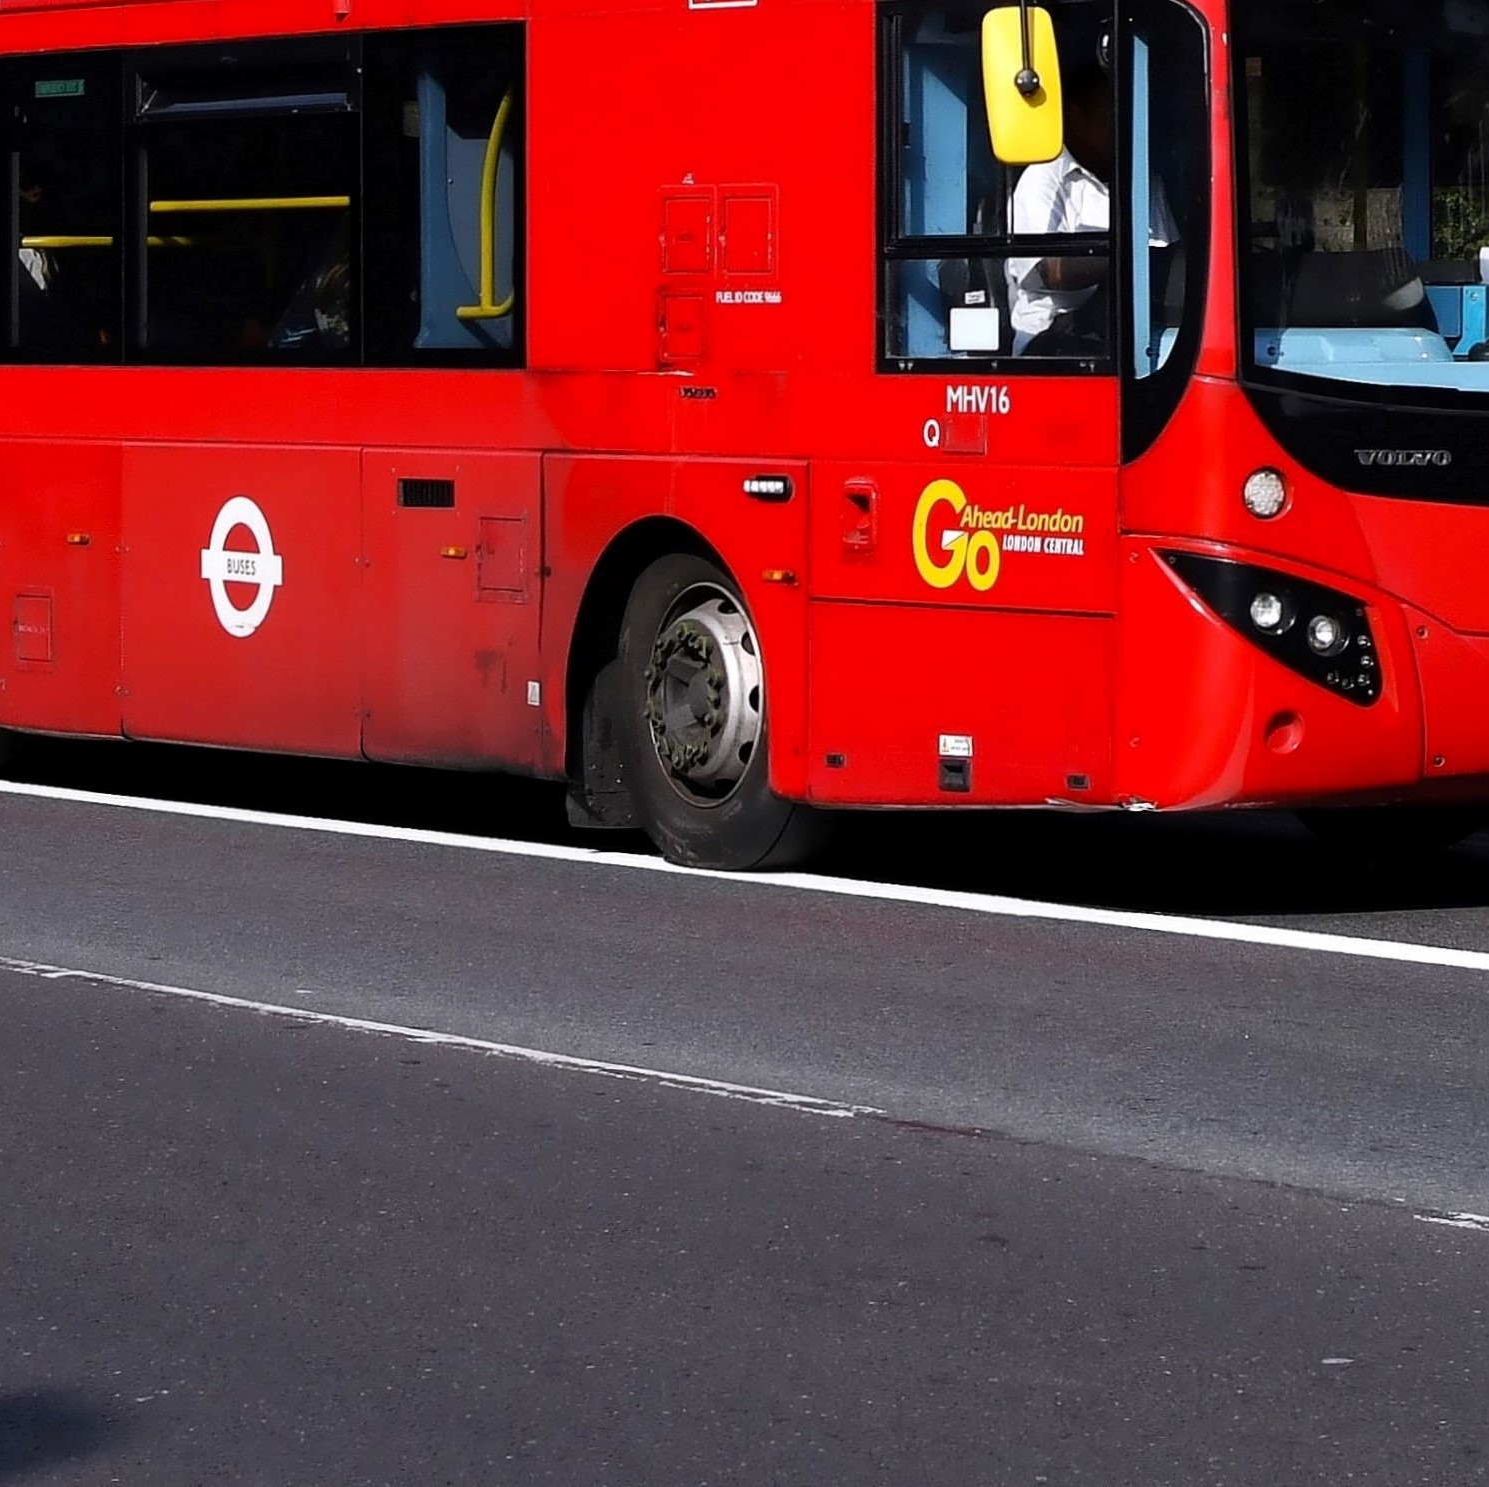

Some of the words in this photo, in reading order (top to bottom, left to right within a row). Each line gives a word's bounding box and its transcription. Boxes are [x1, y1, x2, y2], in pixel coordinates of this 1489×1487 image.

[946, 386, 1010, 414] MHV16
[923, 419, 940, 447] Q
[1354, 449, 1451, 466] VOLVO
[912, 479, 1000, 592] Go
[1002, 534, 1042, 553] LONDON
[1043, 537, 1084, 556] CENTRAL
[227, 558, 256, 576] BUSES
